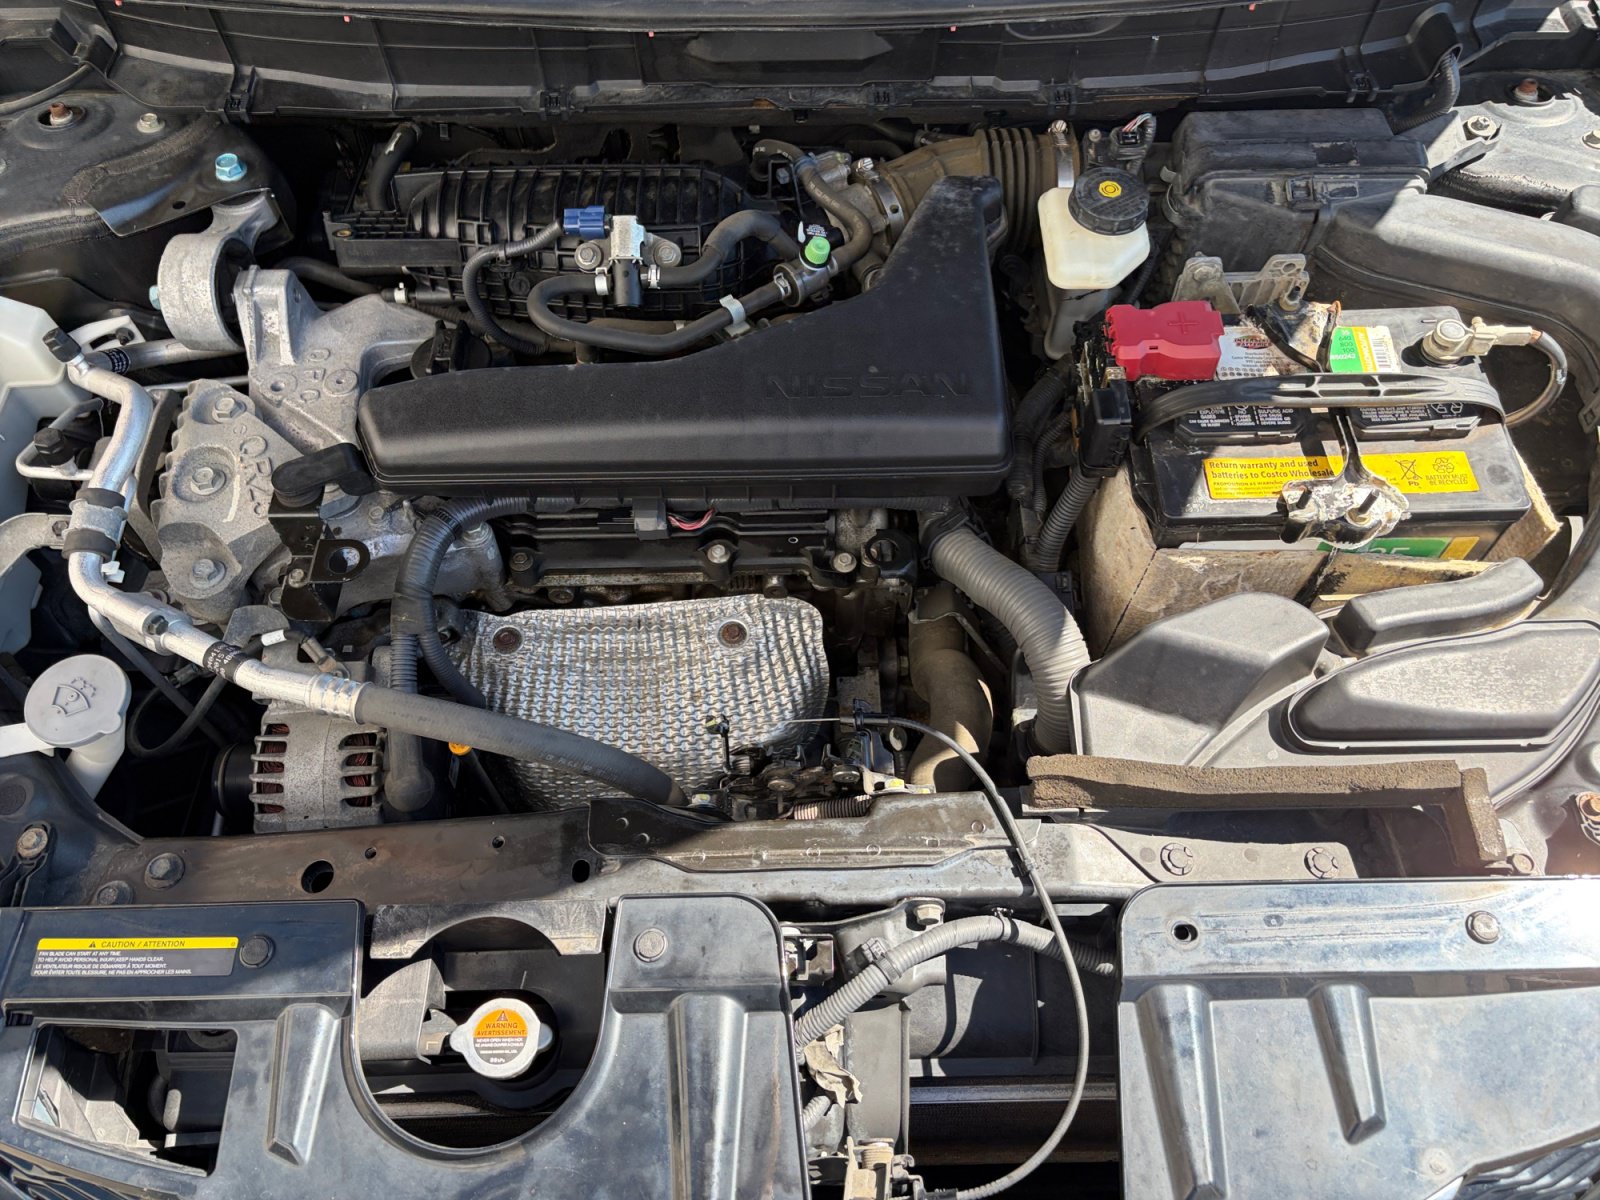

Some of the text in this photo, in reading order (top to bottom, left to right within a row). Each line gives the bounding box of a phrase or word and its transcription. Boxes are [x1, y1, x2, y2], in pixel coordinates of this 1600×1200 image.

[1358, 332, 1374, 372] AUTOMOTIV
[765, 374, 970, 400] NISSAN
[1209, 458, 1318, 471] Return warranty and used
[1212, 468, 1335, 480] batteries to Costco Wholesale
